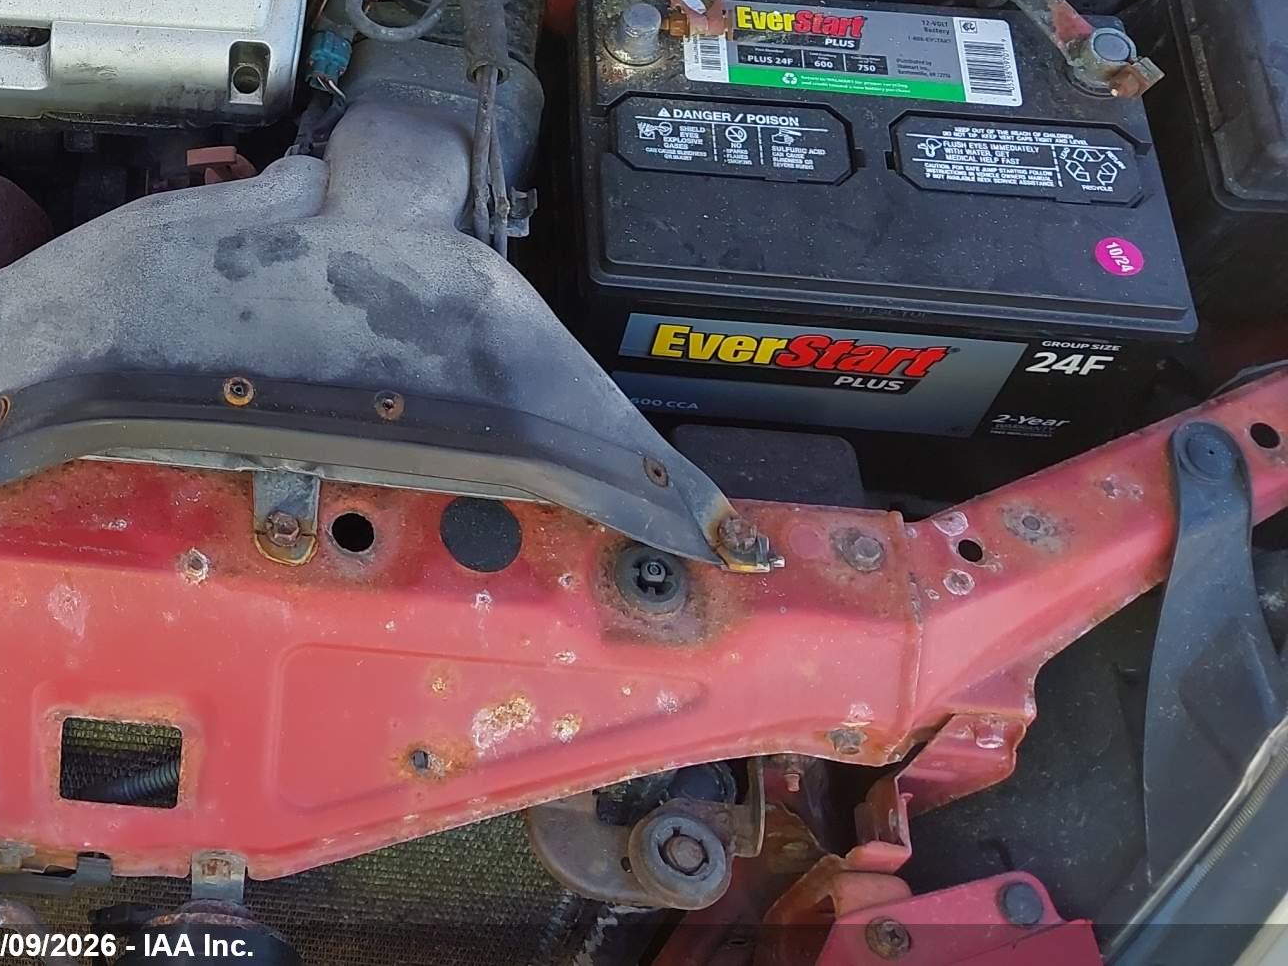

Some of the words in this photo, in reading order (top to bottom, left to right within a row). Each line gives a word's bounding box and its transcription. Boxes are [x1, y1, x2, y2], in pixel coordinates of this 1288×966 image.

[736, 5, 865, 38] EverStart
[824, 38, 856, 48] PLUS
[747, 54, 773, 64] PLUS
[775, 56, 794, 66] 24F
[814, 60, 833, 68] 600
[857, 64, 876, 72] 750
[673, 109, 732, 122] DANGER
[747, 114, 800, 126] POISON
[679, 125, 706, 133] SHIELD
[990, 143, 1039, 153] IMMEDIATELY
[946, 153, 978, 161] MEDICAL
[1105, 241, 1135, 273] 10/24
[650, 323, 950, 378] EverStart
[1041, 339, 1089, 350] GROUP
[1091, 342, 1122, 352] SIZE
[1025, 351, 1114, 376] 24F
[833, 375, 905, 392] PLUS
[665, 400, 700, 411] CCA
[991, 414, 1071, 428] 2-Year
